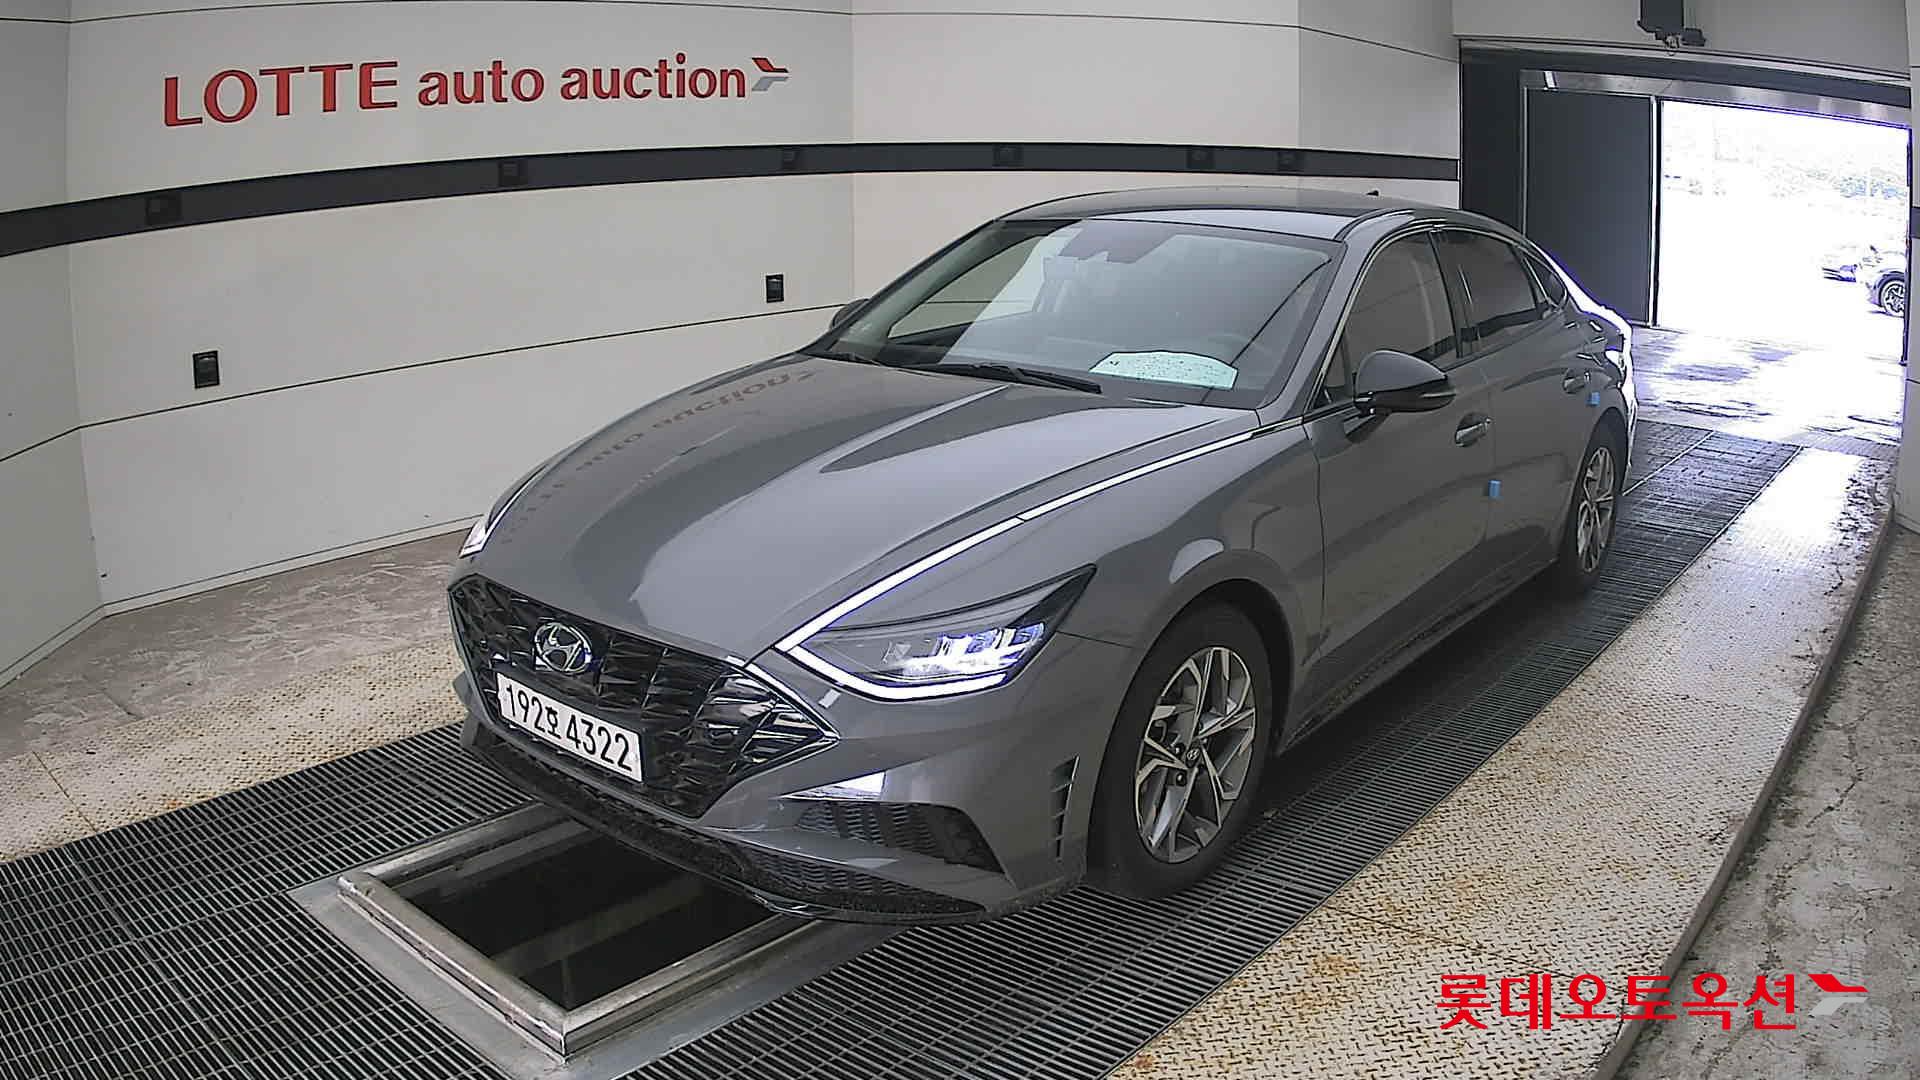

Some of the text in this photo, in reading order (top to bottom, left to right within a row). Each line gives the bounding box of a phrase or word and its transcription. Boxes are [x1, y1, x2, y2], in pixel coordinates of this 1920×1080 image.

[163, 53, 747, 127] LOTTE auto auction
[566, 714, 633, 772] 4322
